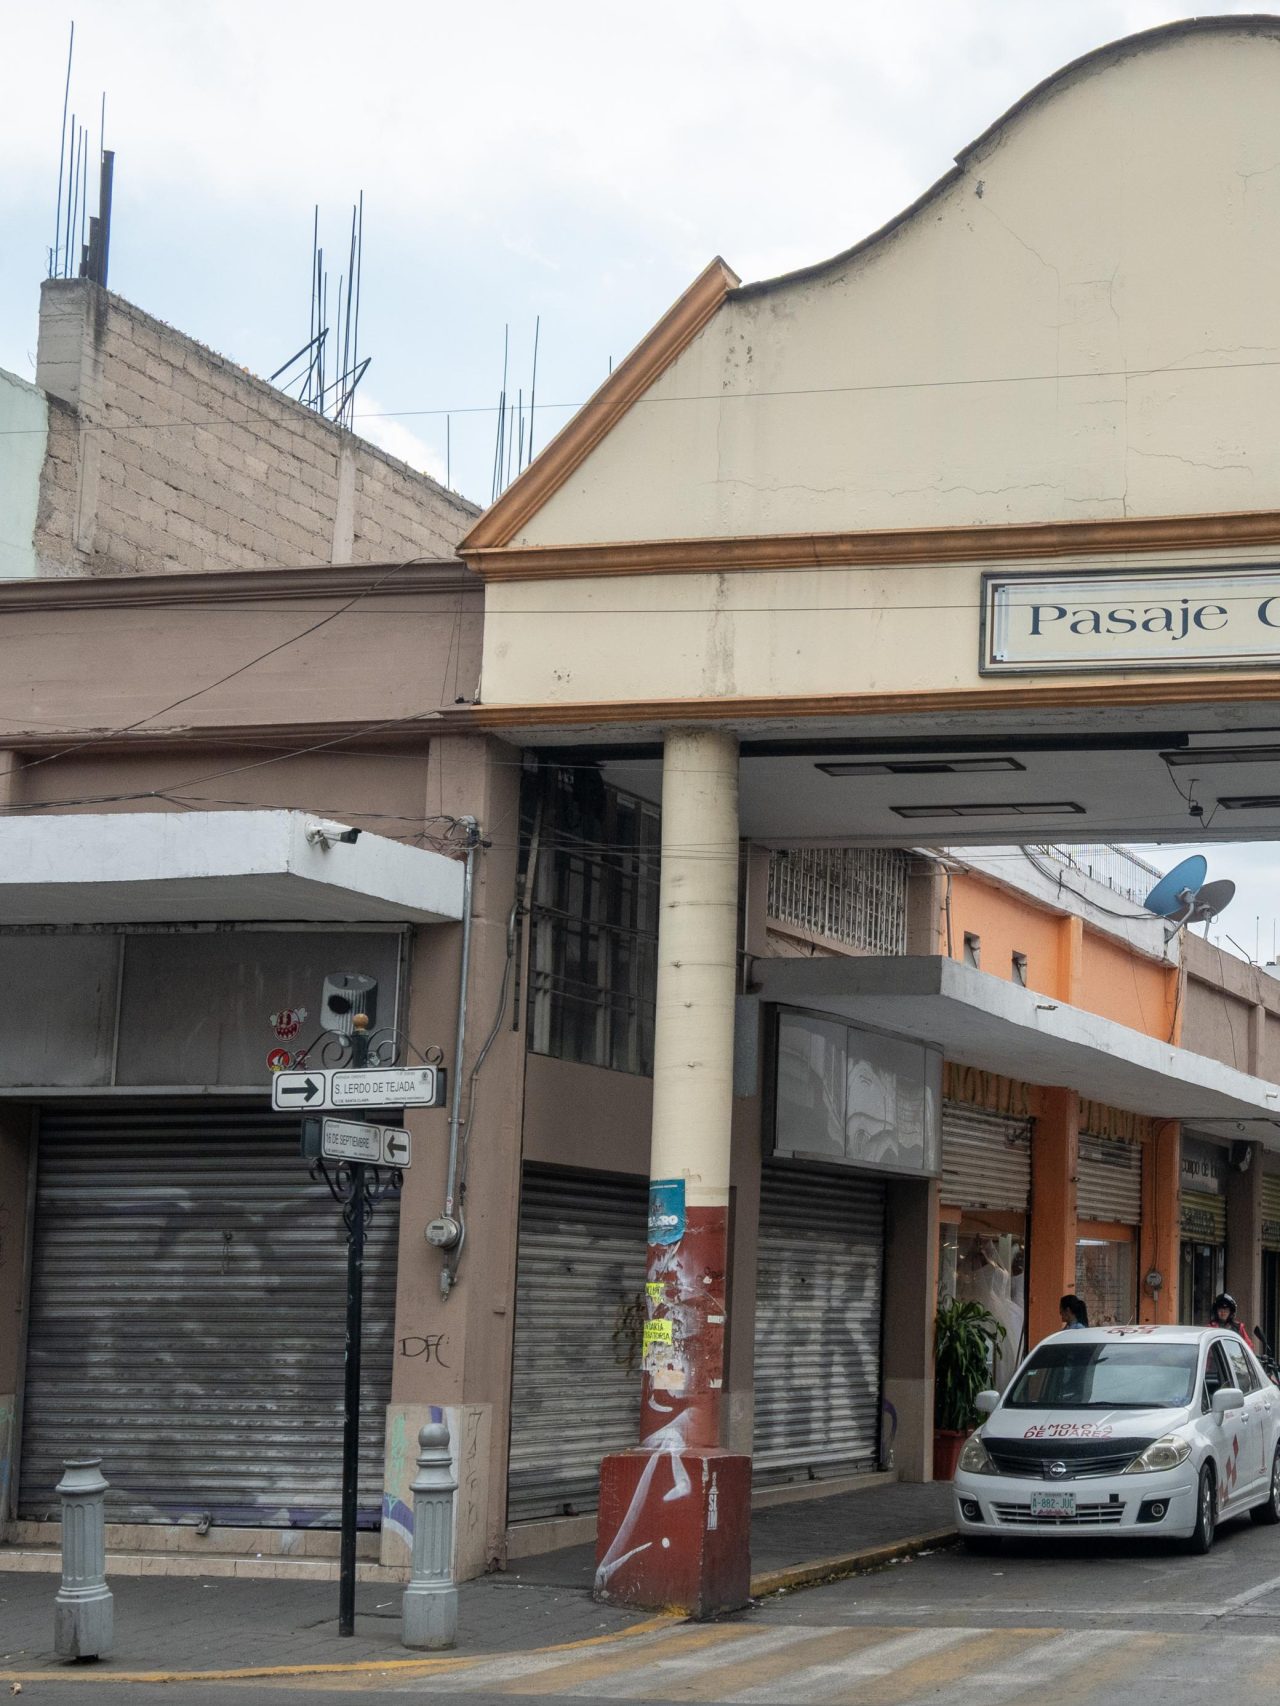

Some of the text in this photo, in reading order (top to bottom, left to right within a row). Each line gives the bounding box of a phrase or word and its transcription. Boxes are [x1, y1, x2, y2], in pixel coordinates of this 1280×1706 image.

[1029, 597, 1229, 641] Pasaje
[334, 1084, 342, 1095] S.
[343, 1082, 371, 1094] LERDO
[372, 1082, 384, 1093] DE
[385, 1081, 415, 1092] TEJADA
[332, 1133, 339, 1144] DE
[339, 1134, 370, 1149] SEPTIEMBRE
[1024, 1429, 1113, 1439] DE JUAREZ
[1028, 1423, 1113, 1431] ALMOLOYA
